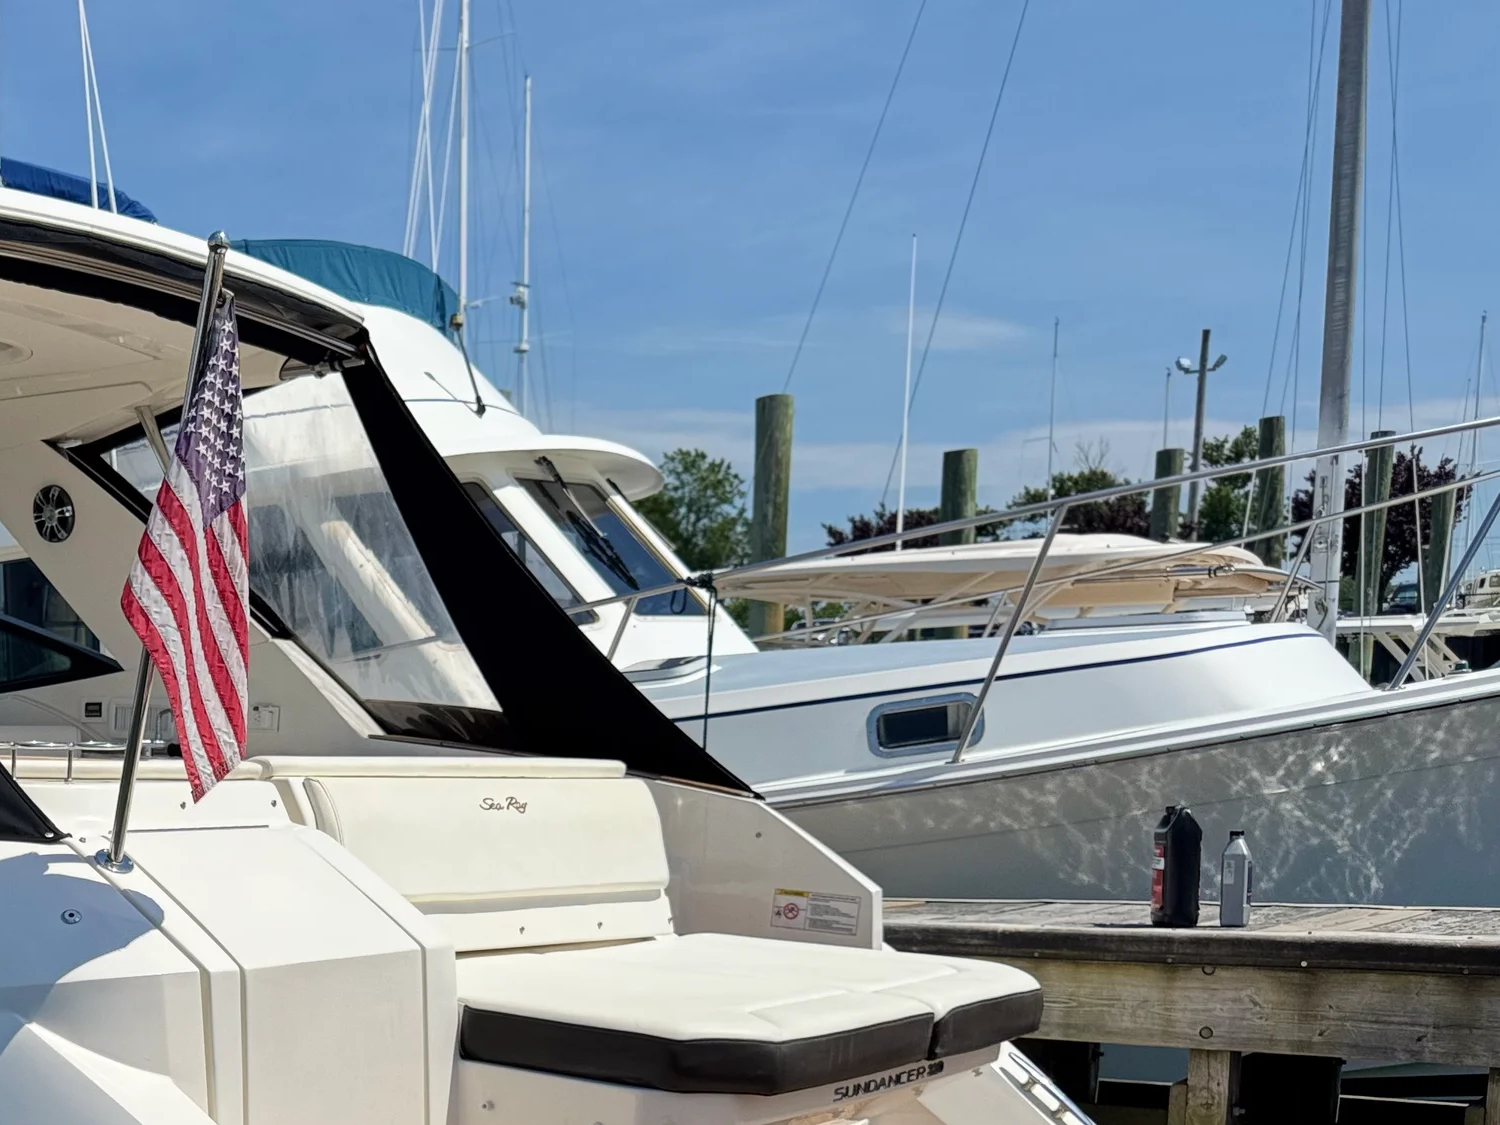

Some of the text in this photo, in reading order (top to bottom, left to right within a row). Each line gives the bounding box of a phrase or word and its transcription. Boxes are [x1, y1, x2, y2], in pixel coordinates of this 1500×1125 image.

[479, 796, 528, 814] Sea Ray
[833, 1065, 927, 1103] SUNDANCER
